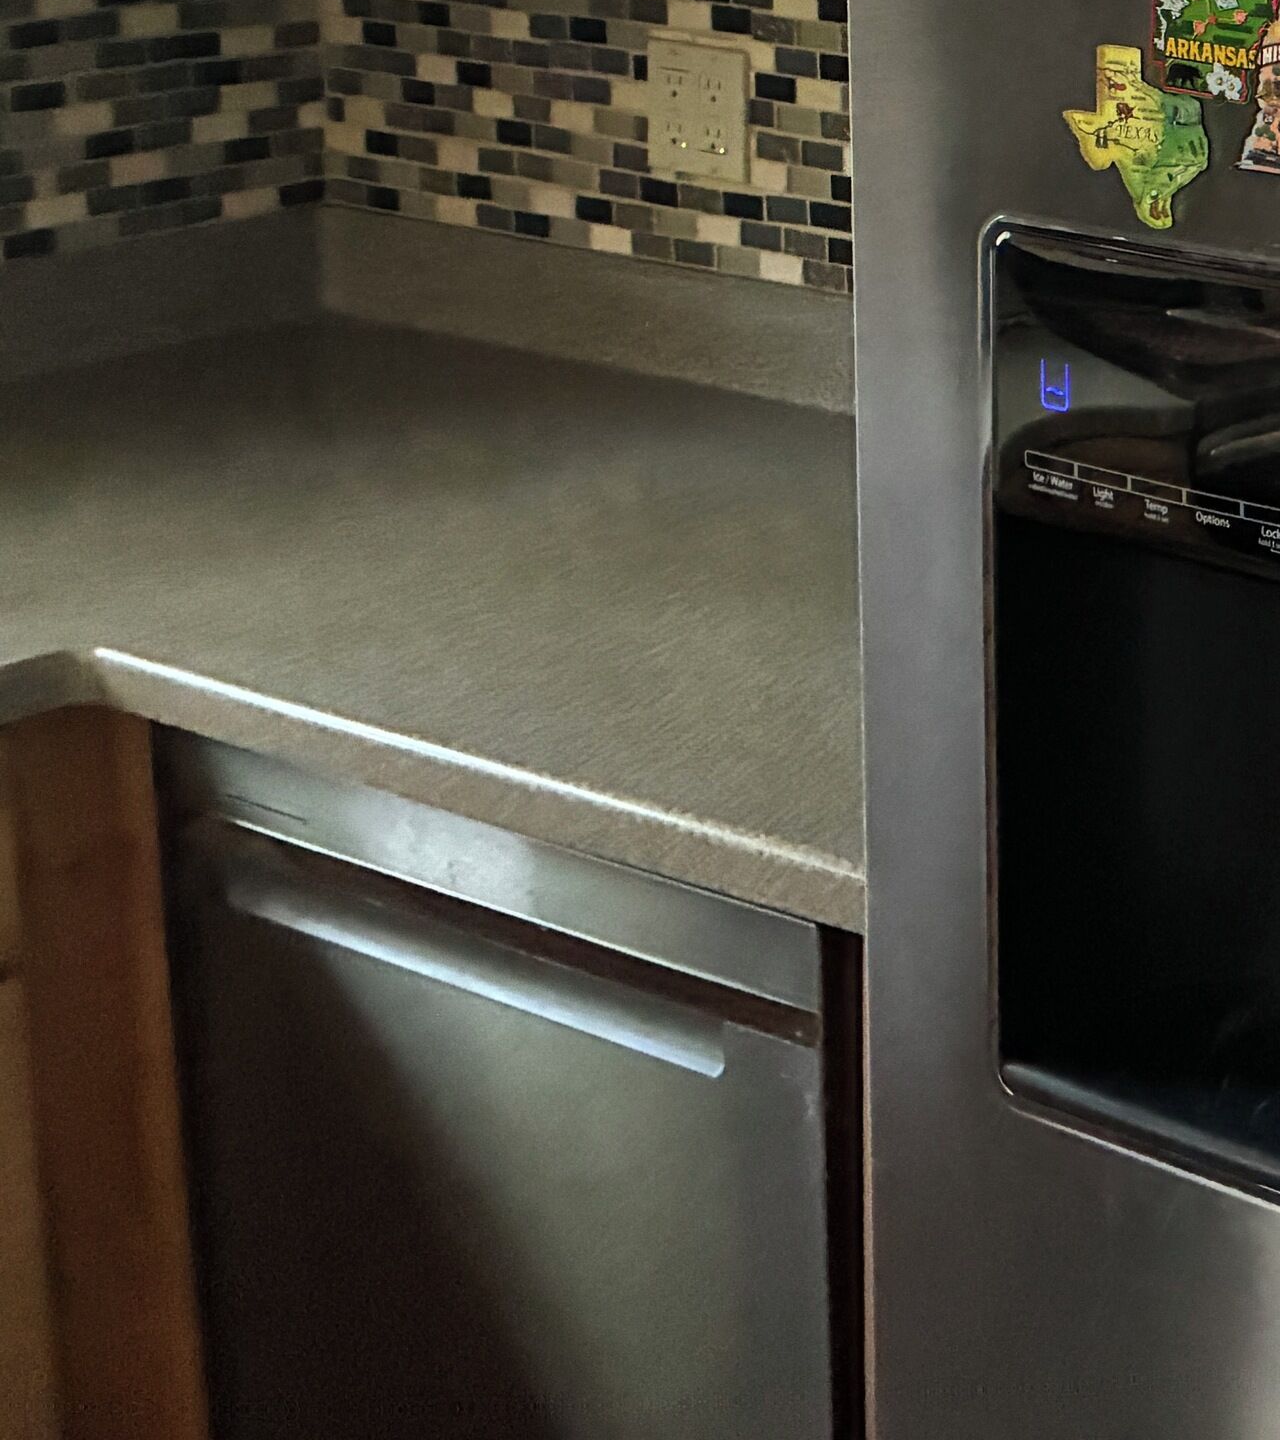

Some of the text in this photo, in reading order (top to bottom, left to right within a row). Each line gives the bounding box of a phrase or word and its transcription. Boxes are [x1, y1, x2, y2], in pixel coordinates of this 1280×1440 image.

[1116, 125, 1159, 145] TEXAS
[1144, 498, 1169, 516] Temp
[1195, 510, 1231, 529] Options
